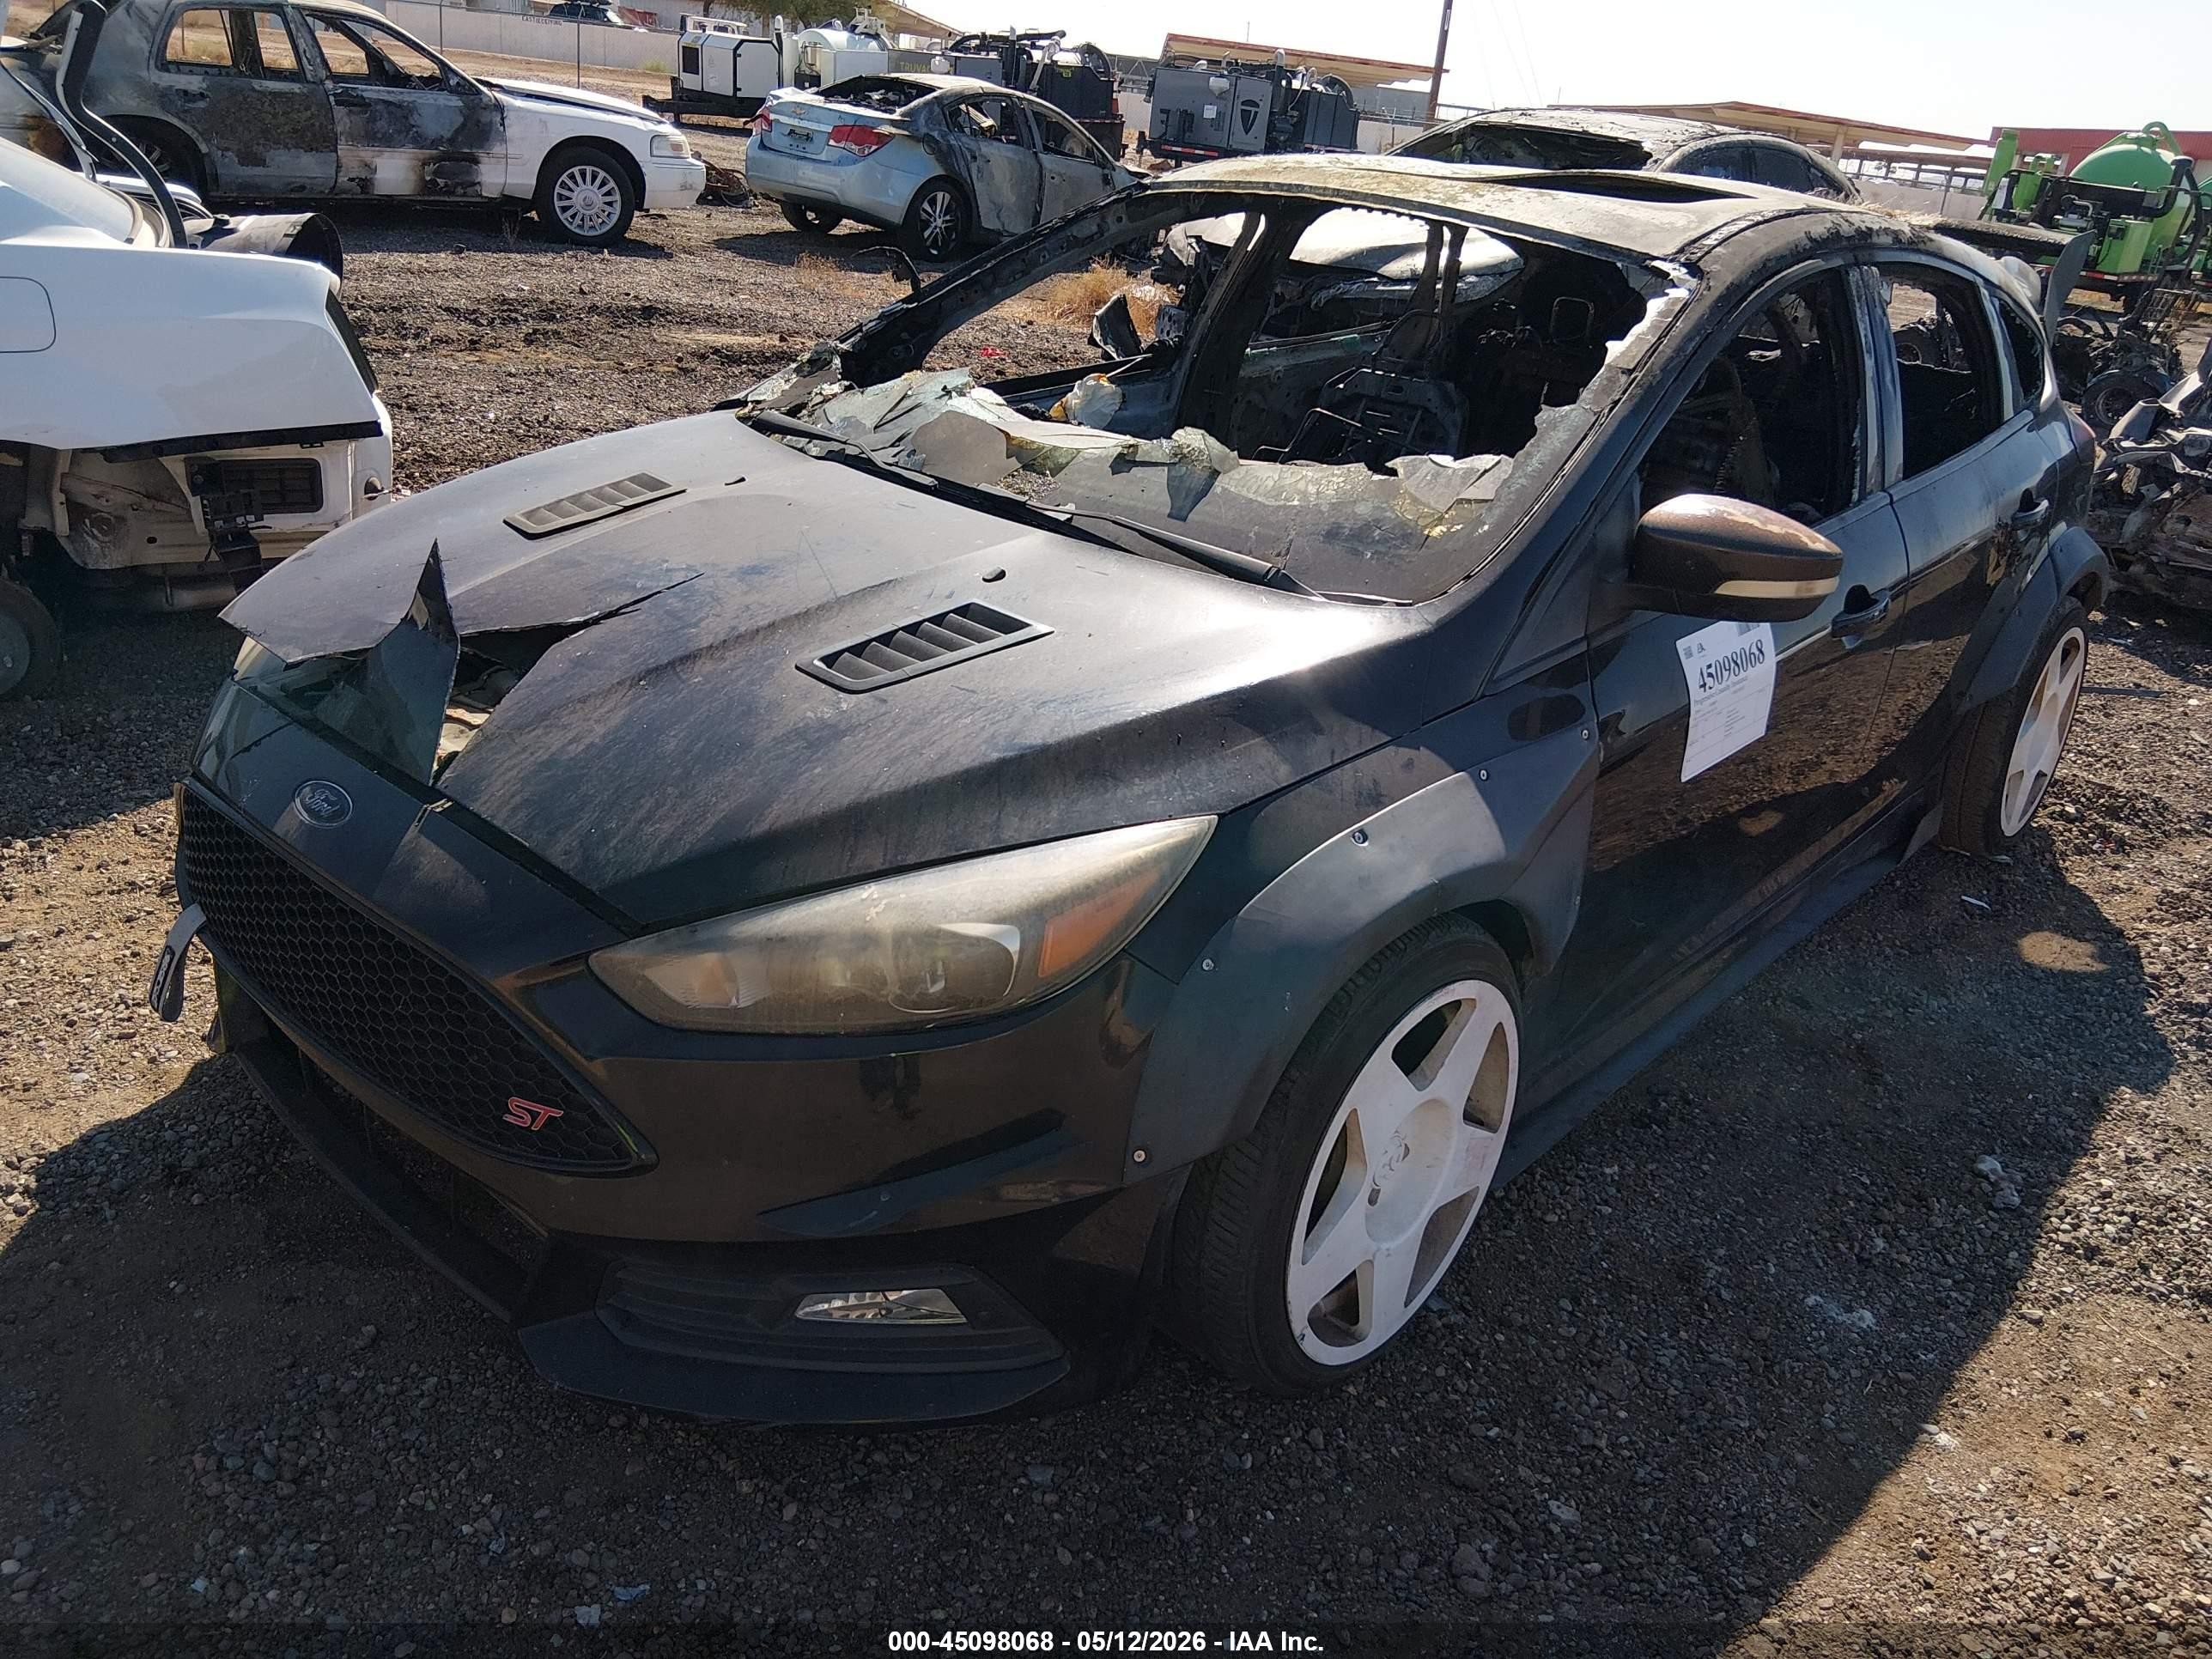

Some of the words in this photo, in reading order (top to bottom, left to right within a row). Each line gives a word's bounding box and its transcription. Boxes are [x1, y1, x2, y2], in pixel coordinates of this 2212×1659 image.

[1698, 639, 1765, 693] 45098068
[303, 788, 340, 817] Ford
[501, 1097, 564, 1131] ST
